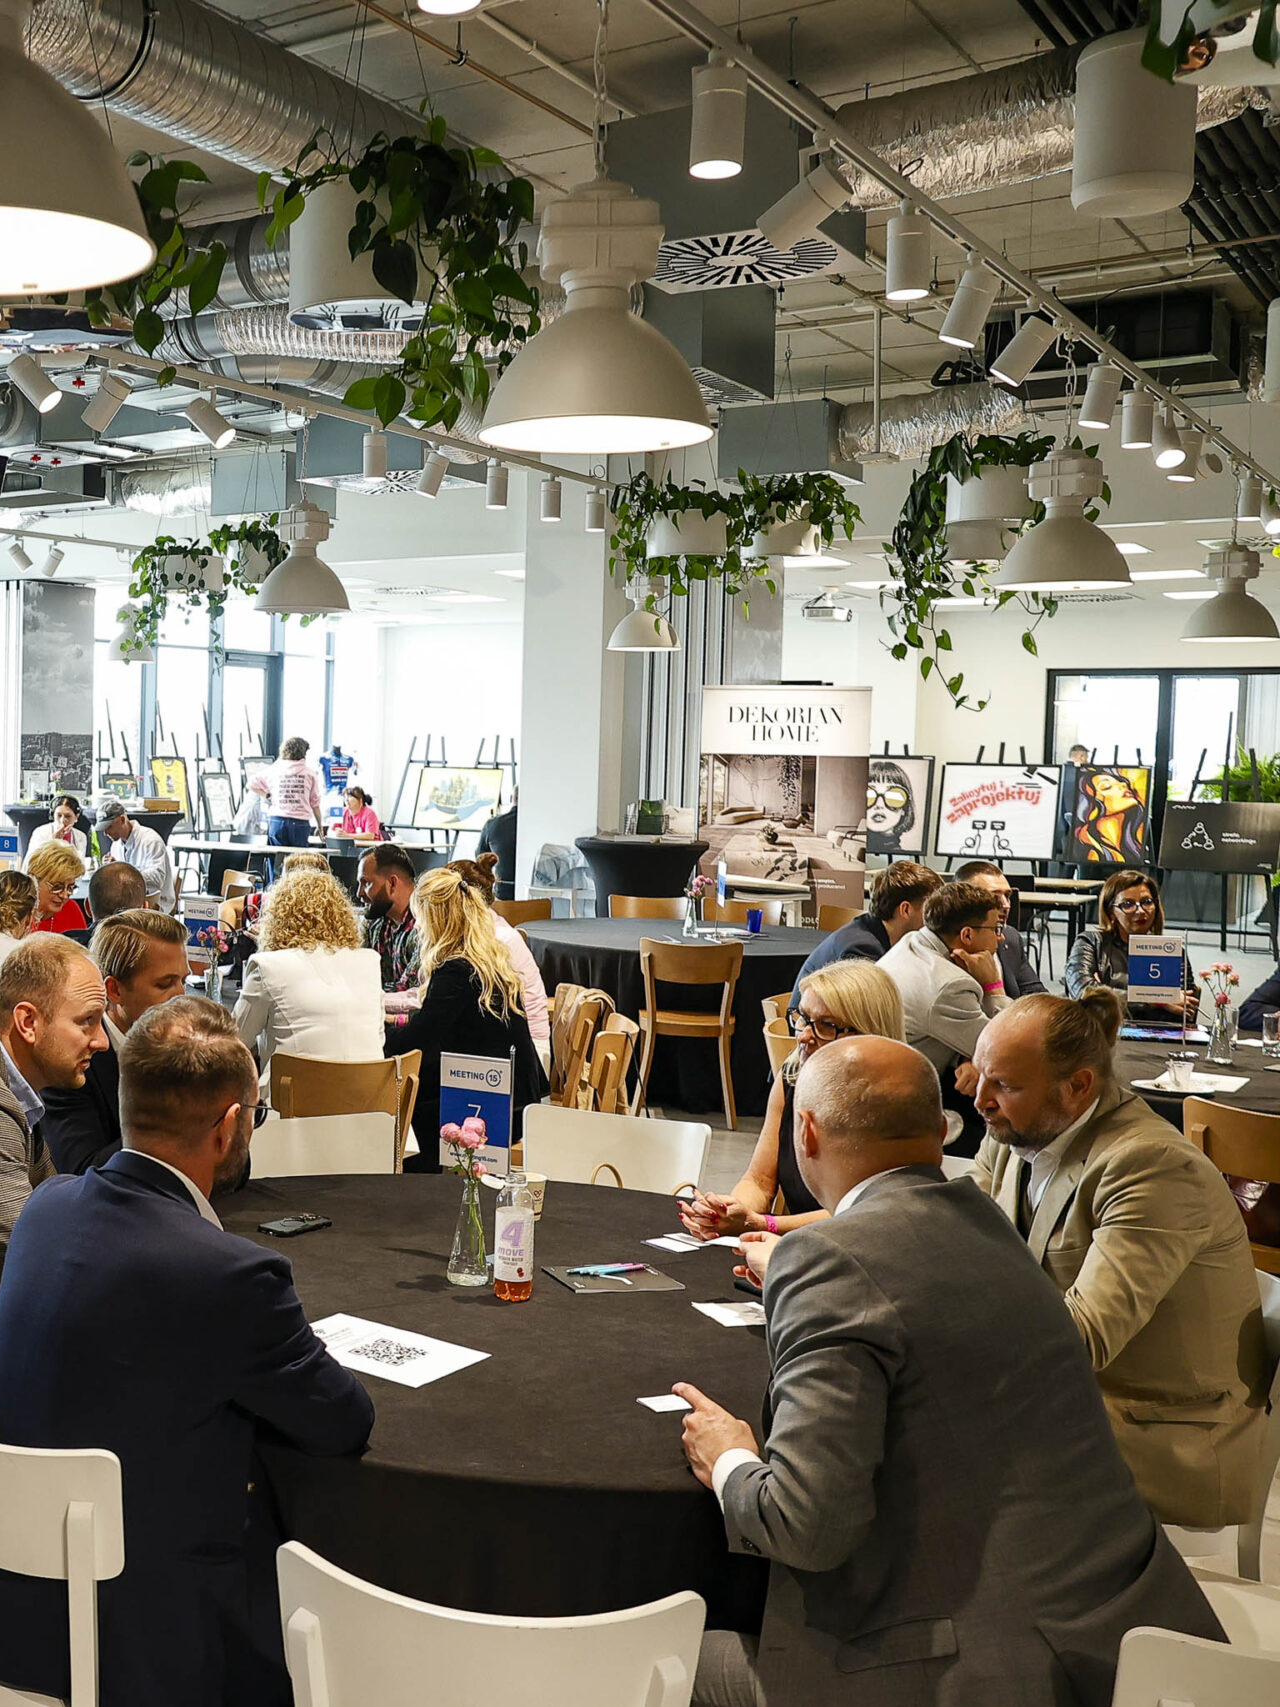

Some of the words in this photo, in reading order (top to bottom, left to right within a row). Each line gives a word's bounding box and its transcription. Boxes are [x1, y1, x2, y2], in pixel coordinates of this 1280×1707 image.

[729, 706, 843, 725] DEKORIAN
[752, 725, 819, 742] HOME
[946, 787, 1042, 824] zaprojektuj
[3, 839, 10, 849] 8
[1148, 963, 1161, 979] 5
[450, 1069, 484, 1081] MEETING
[501, 1220, 524, 1247] 4
